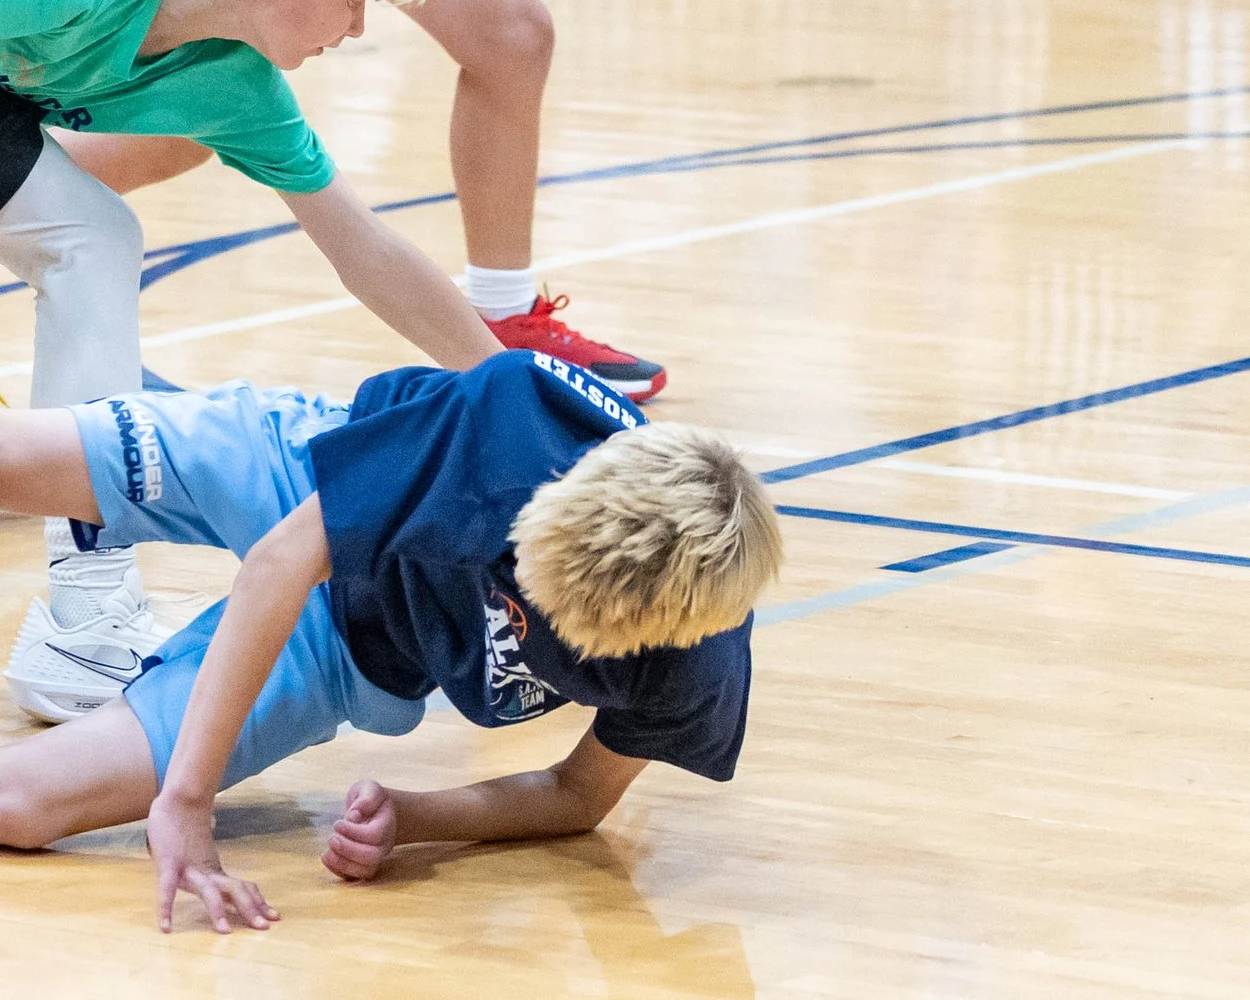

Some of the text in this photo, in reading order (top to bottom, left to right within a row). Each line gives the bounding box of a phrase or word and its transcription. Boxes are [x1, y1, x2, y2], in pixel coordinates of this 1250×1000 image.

[532, 350, 637, 430] ROSTER
[107, 400, 144, 503] ARMOUR
[132, 402, 163, 504] UNDER
[521, 689, 545, 711] TEAM
